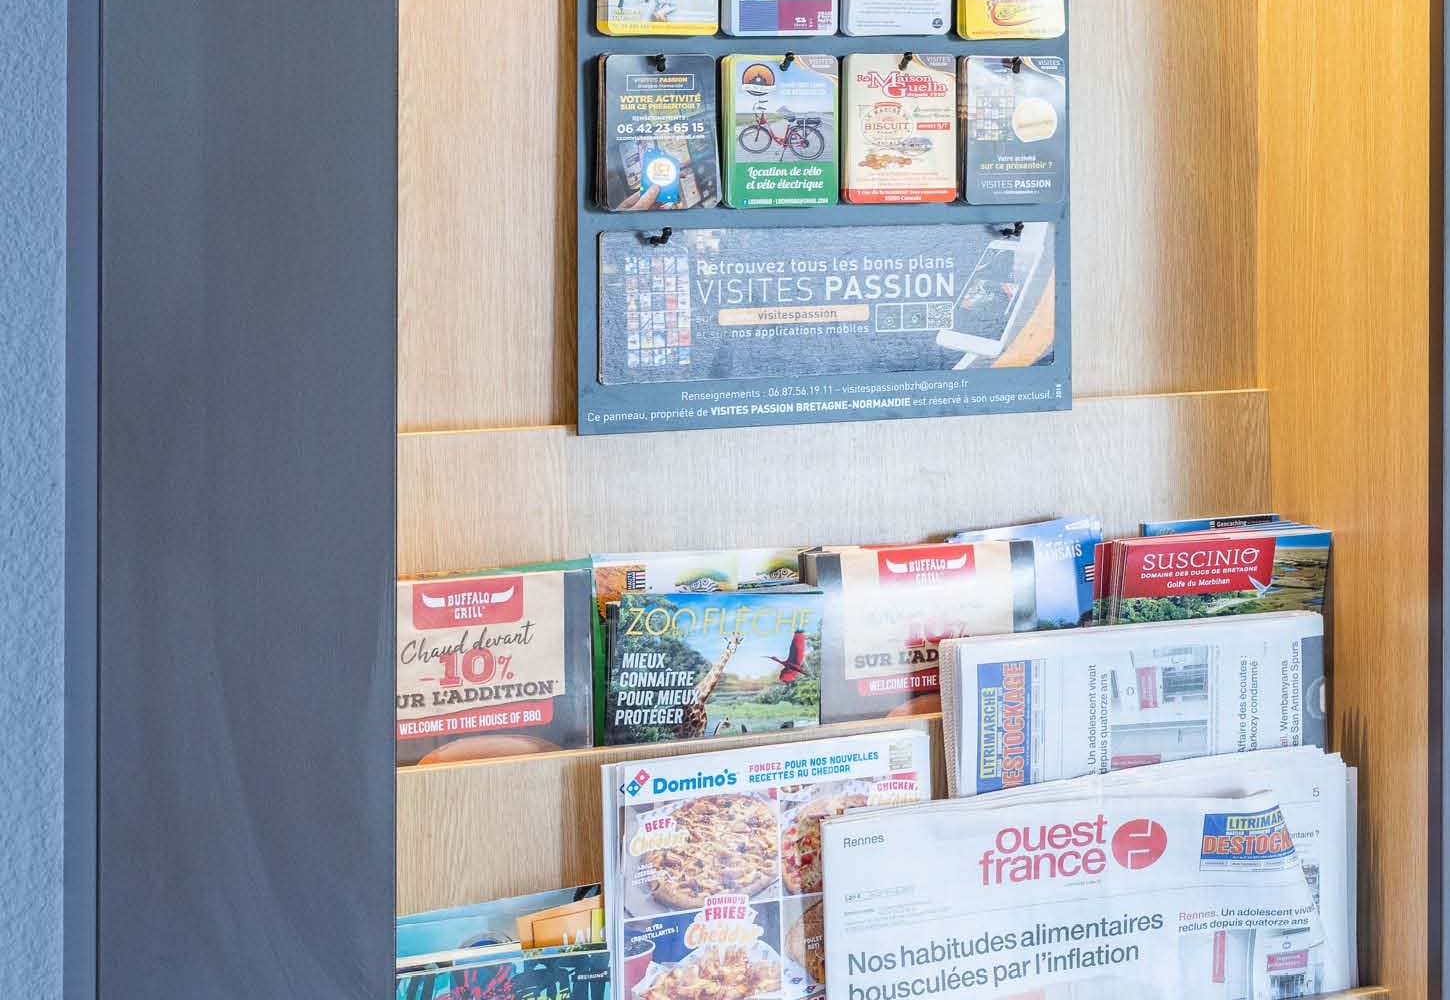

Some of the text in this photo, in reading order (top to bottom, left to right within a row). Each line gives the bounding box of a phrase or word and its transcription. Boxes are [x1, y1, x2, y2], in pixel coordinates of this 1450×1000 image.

[868, 71, 933, 88] Maison
[620, 92, 702, 103] VOTRE ACTIVITÉ
[617, 122, 705, 134] 06 42 23 65 15
[747, 165, 823, 178] Location de vélo
[757, 178, 824, 192] vélo électrique
[982, 178, 1051, 188] VISITES PASSION
[697, 254, 955, 275] Retrouvez tous les bons plans
[696, 273, 955, 305] VISITES PASSION
[732, 323, 870, 341] nos applications mobiles
[682, 388, 760, 403] Renseignements
[587, 412, 601, 423] Ce
[603, 410, 648, 425] panneau,
[651, 406, 693, 420] propriété
[696, 406, 708, 417] de
[711, 404, 749, 416] VISITES
[751, 402, 794, 415] PASSION
[796, 397, 911, 413] BRETAGNE-NORMANDIE
[971, 395, 987, 403] son
[989, 393, 1015, 404] usage
[1017, 390, 1051, 400] exclusif
[909, 558, 946, 573] BUFFALO
[1142, 547, 1260, 571] SUSCINIO
[1140, 571, 1173, 579] DOMAINE
[1175, 569, 1189, 577] DES
[1222, 565, 1258, 573] BRETAGNE
[1167, 577, 1230, 589] Golfe du Morbihan
[447, 591, 490, 606] BUFFALO
[454, 606, 483, 620] GRILL
[625, 607, 697, 637] ZOO
[400, 620, 536, 665] Chaud devant
[622, 652, 665, 669] MIEUX
[854, 651, 892, 669] SUR
[619, 668, 695, 687] CONNAÎTRE
[869, 674, 937, 691] WELCOME TO THE
[1290, 640, 1300, 733] San Antonio Spurs
[1238, 660, 1247, 720] des écoutes
[1249, 660, 1259, 714] condamné
[1280, 660, 1290, 732] Wembanyama
[617, 688, 701, 706] POUR MIEUX
[399, 709, 541, 735] WELCOME TO THE HOUSE OF BBQ
[614, 706, 684, 726] PROTÉGER
[1087, 664, 1097, 765] Un adolescent vivait
[983, 688, 996, 777] LITRIMARCHE
[1099, 673, 1110, 775] depuis quatorze ans
[749, 751, 879, 773] FONDEZ POUR NOS NOUVELLES
[653, 768, 737, 794] Domino's
[749, 764, 850, 783] RECETTES AU CHEDDAR
[1312, 786, 1320, 798] 5
[645, 818, 671, 833] BEEF
[995, 814, 1108, 854] ouest
[843, 833, 885, 849] Rennes
[978, 848, 1107, 887] france
[704, 906, 746, 921] FRIES
[1178, 907, 1292, 921] Rennes. Un adolescent
[1178, 917, 1309, 933] reclus depuis quatorze ans
[848, 912, 1164, 975] Nos habitudes alimentaires
[849, 942, 1140, 1000] bousculées par l'inflation
